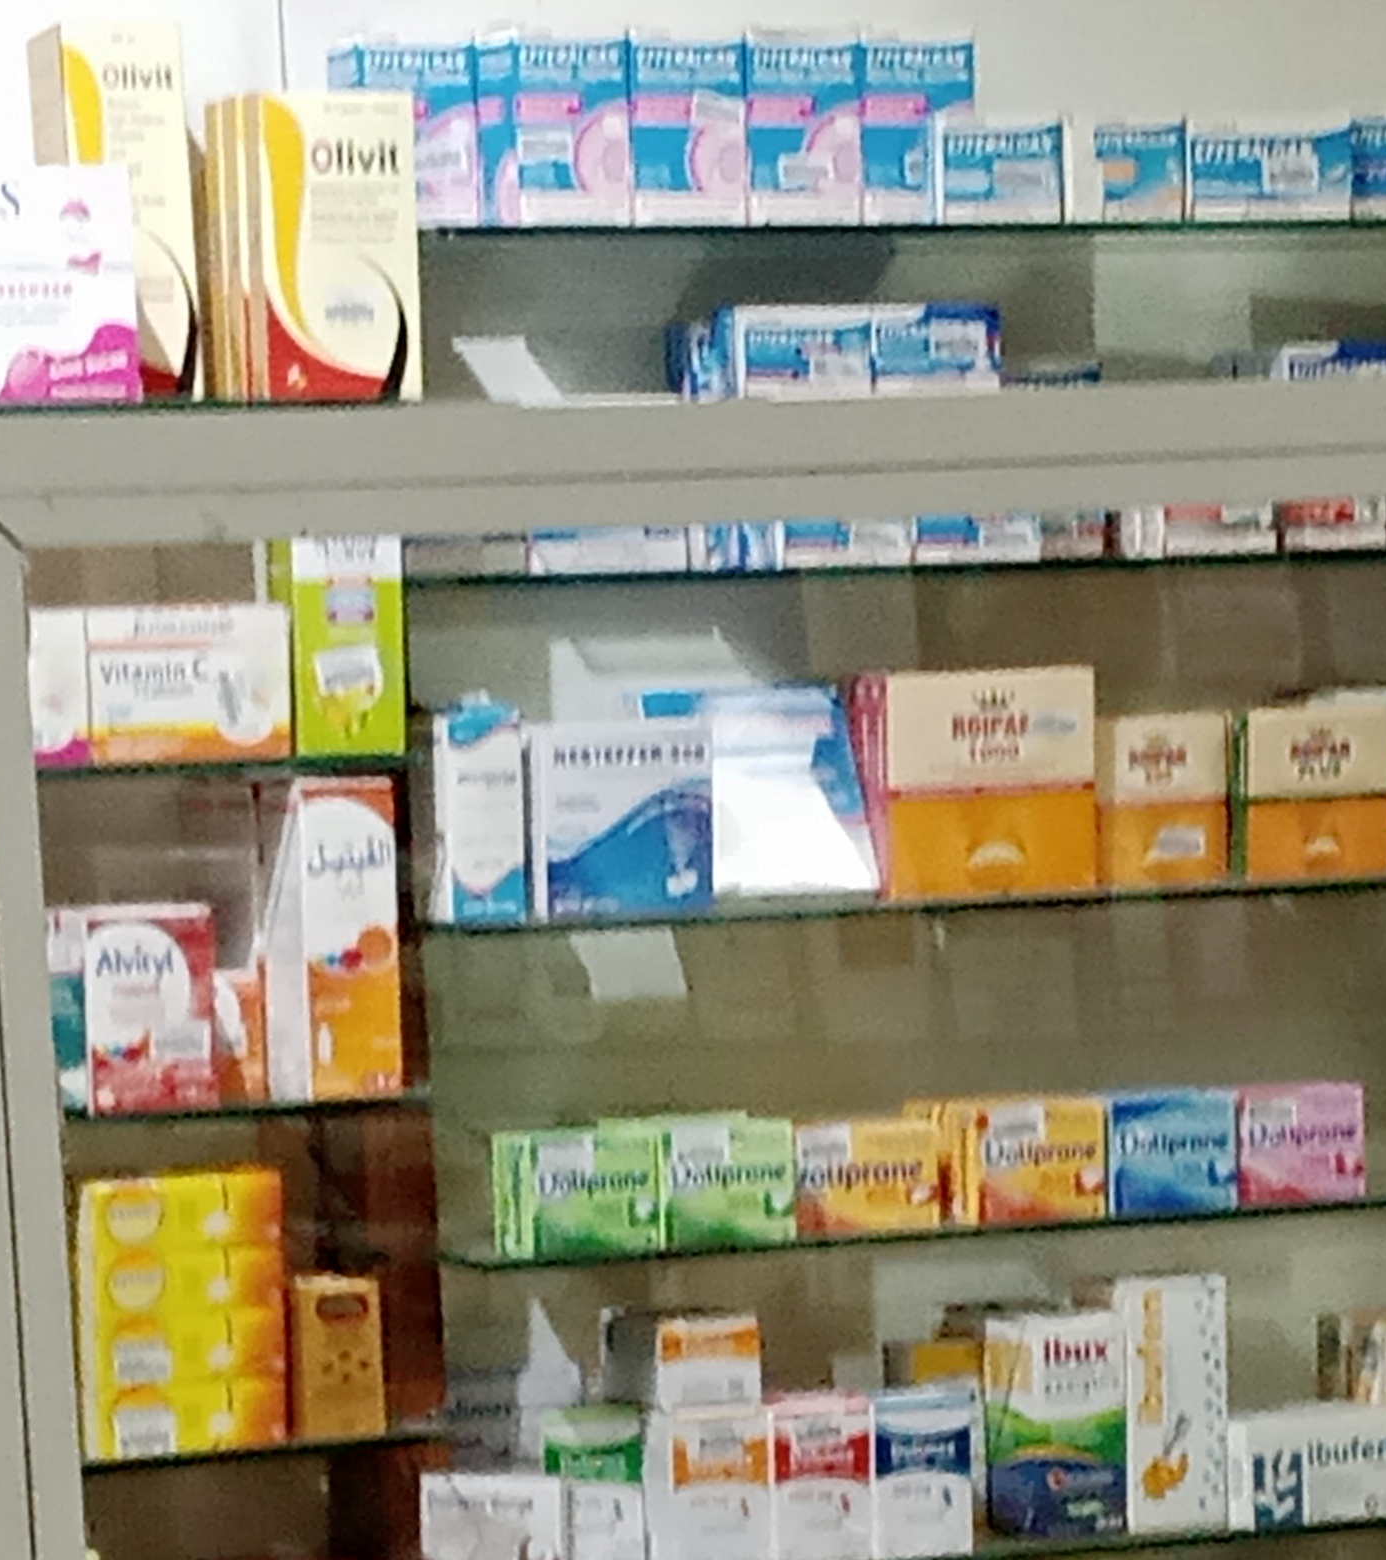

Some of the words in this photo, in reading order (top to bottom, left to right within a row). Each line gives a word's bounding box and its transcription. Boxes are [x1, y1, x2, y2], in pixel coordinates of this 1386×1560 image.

[102, 63, 173, 91] Olivit
[311, 137, 400, 175] Olivit
[98, 657, 186, 685] Vitamin
[1043, 1337, 1109, 1367] Ibux
